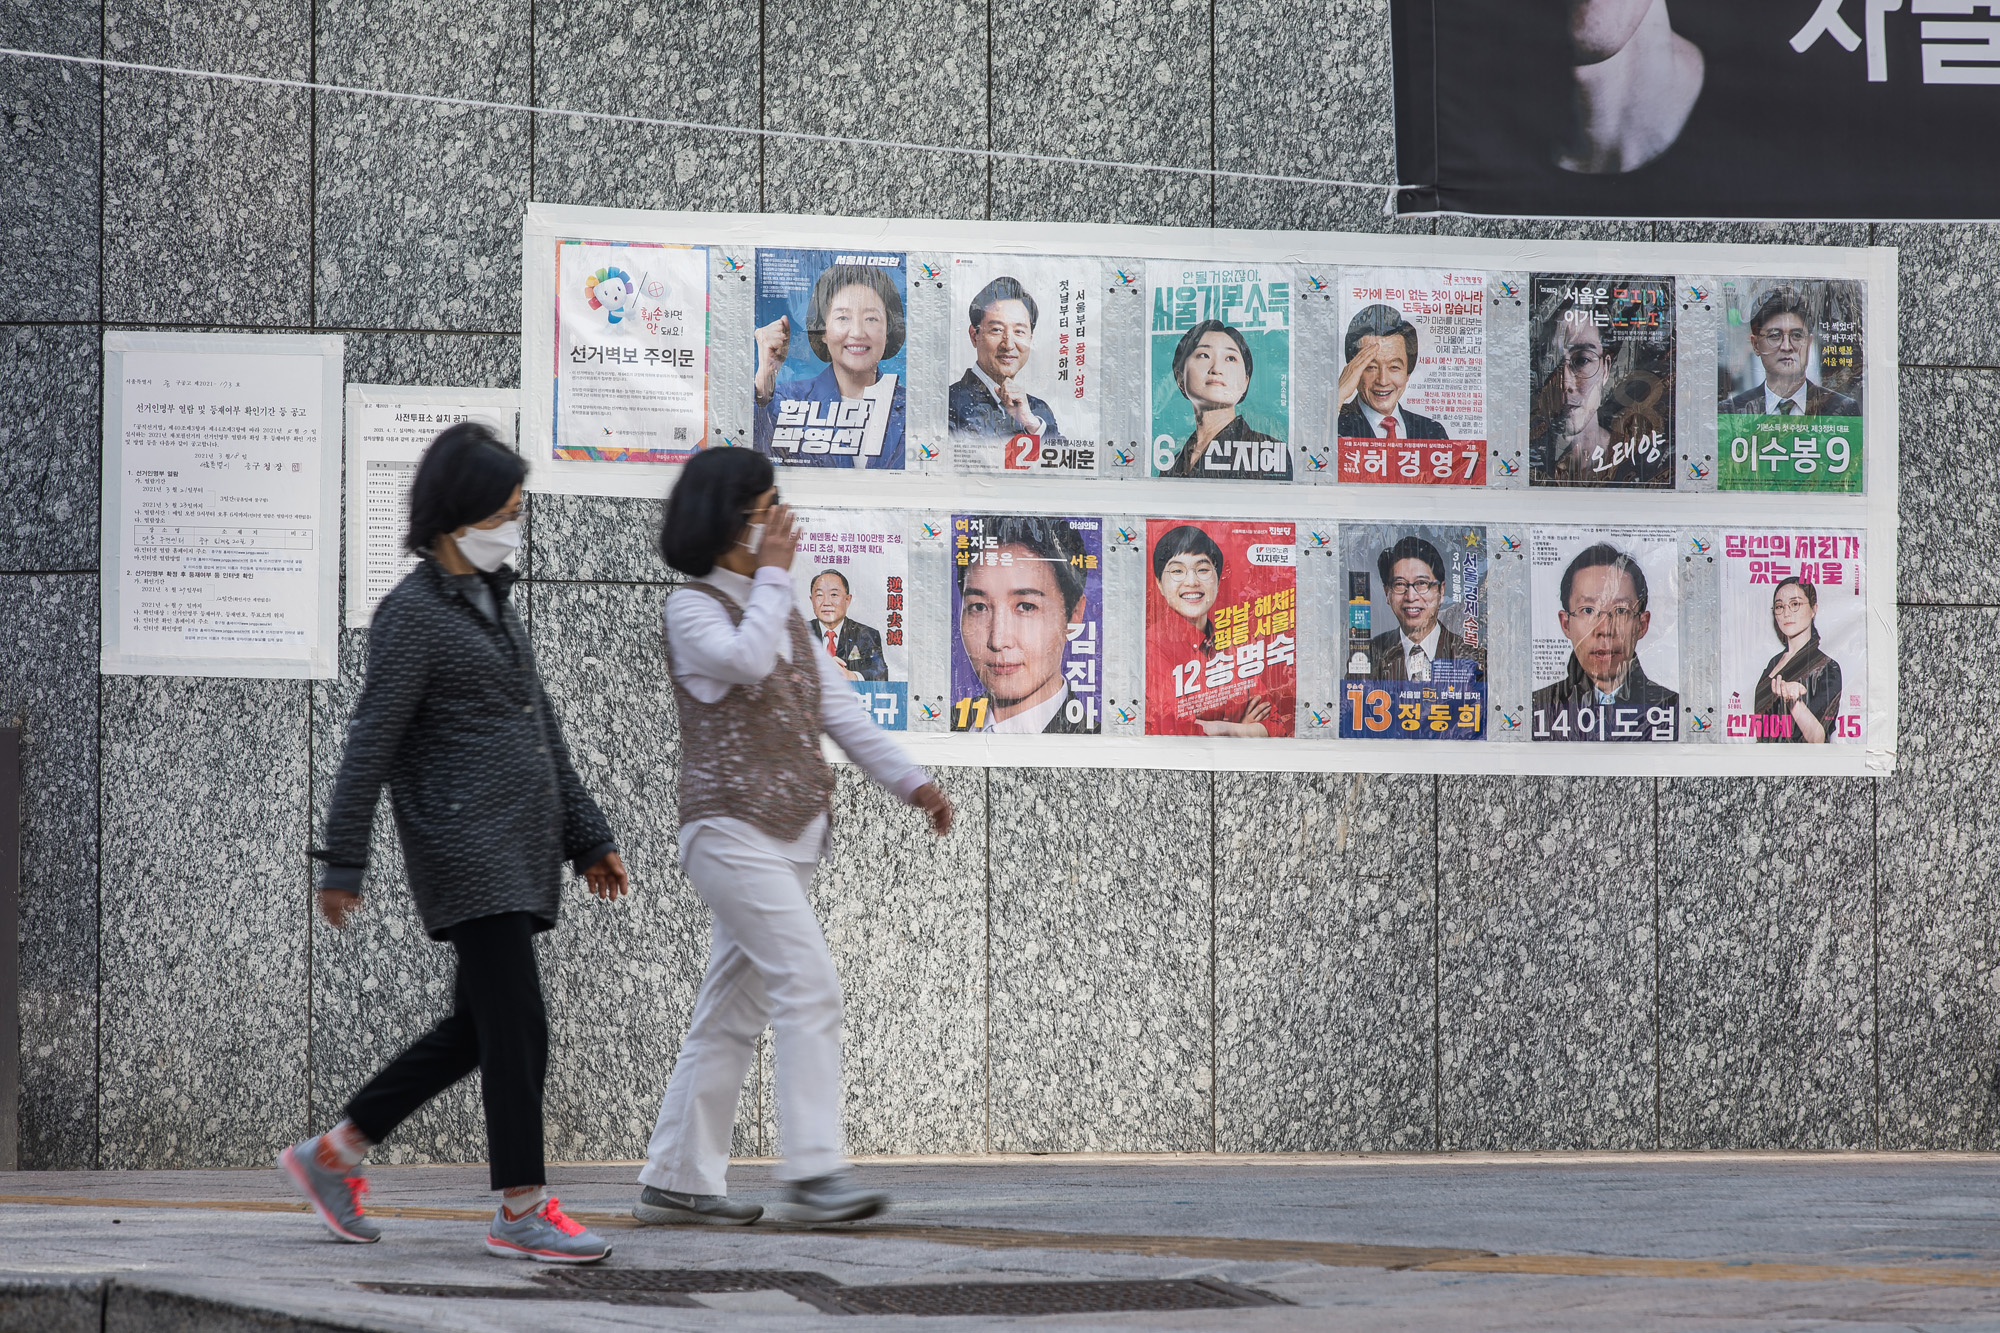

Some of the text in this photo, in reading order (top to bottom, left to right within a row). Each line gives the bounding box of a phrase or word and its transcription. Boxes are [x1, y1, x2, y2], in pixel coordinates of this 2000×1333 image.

[835, 256, 900, 267] 서울시 대전환
[1454, 276, 1483, 284] 국가혁명당
[1353, 288, 1483, 302] 국가에 돈이 없는 것이 아니라
[1564, 287, 1664, 306] 서울은 무지개
[640, 306, 682, 321] 훼손하면
[1075, 289, 1086, 338] 서울부터
[1152, 283, 1290, 331] 서울기본소득
[1403, 302, 1482, 316] 도둑놈이 많습니다
[1416, 315, 1482, 326] 국가 미래를 내다보는
[1564, 310, 1664, 328] 이기는 소수자
[647, 323, 683, 337] 안 돼요!
[1058, 280, 1070, 381] 첫날부터 능숙하게
[1430, 326, 1457, 335] 허경영이
[1434, 336, 1441, 344] 그
[1443, 336, 1464, 344] 나물에
[571, 345, 694, 368] 선거벽보 주의문
[1436, 346, 1482, 355] 이제 끝냅시다.
[1822, 346, 1837, 355] 서민
[1439, 357, 1452, 365] 예산
[1822, 357, 1837, 367] 서울
[136, 403, 306, 417] 선거인명부 열람 및 등재여부 확인기간 등 공고
[395, 413, 468, 423] 사전투표소 설치 공고
[777, 400, 870, 428] 합니다
[1756, 424, 1780, 432] 기본소득
[1782, 424, 1789, 432] 첫
[1837, 425, 1849, 433] 대표
[771, 427, 864, 455] 박영선
[1016, 437, 1033, 469] 2
[1040, 448, 1095, 470] 오세훈
[1153, 434, 1286, 472] 6 신지혜
[1592, 430, 1666, 473] 오태양
[1731, 435, 1850, 473] 이수봉 9
[1462, 452, 1480, 479] 7
[956, 519, 984, 533] 여자
[1070, 520, 1098, 530] 여성의당
[1269, 526, 1291, 536] 진보당
[810, 532, 903, 544] 에덴동산 공원 100만평 조성,
[956, 534, 999, 549] 혼자도
[1725, 535, 1860, 559] 당신의 자리가
[819, 544, 884, 554] 조성, 복지정책 확대,
[814, 556, 850, 564] 예산효율화
[956, 552, 1098, 569] 살기좋은 서울
[1256, 554, 1288, 564] 지지후보
[1463, 552, 1478, 584] 서울
[1749, 561, 1843, 585] 있는 서울
[1214, 588, 1295, 629] 강남 해체!
[1464, 585, 1479, 617] 경제
[1214, 609, 1295, 651] 평등 서울!
[1172, 633, 1295, 698] 12 송명숙
[1065, 621, 1098, 729] 김진아
[955, 697, 989, 728] 11
[1347, 689, 1392, 732] 13
[1398, 703, 1480, 732] 정동희
[1533, 705, 1675, 741] 14 이도엽
[1726, 714, 1792, 738] 신지예
[1837, 715, 1861, 738] 15
